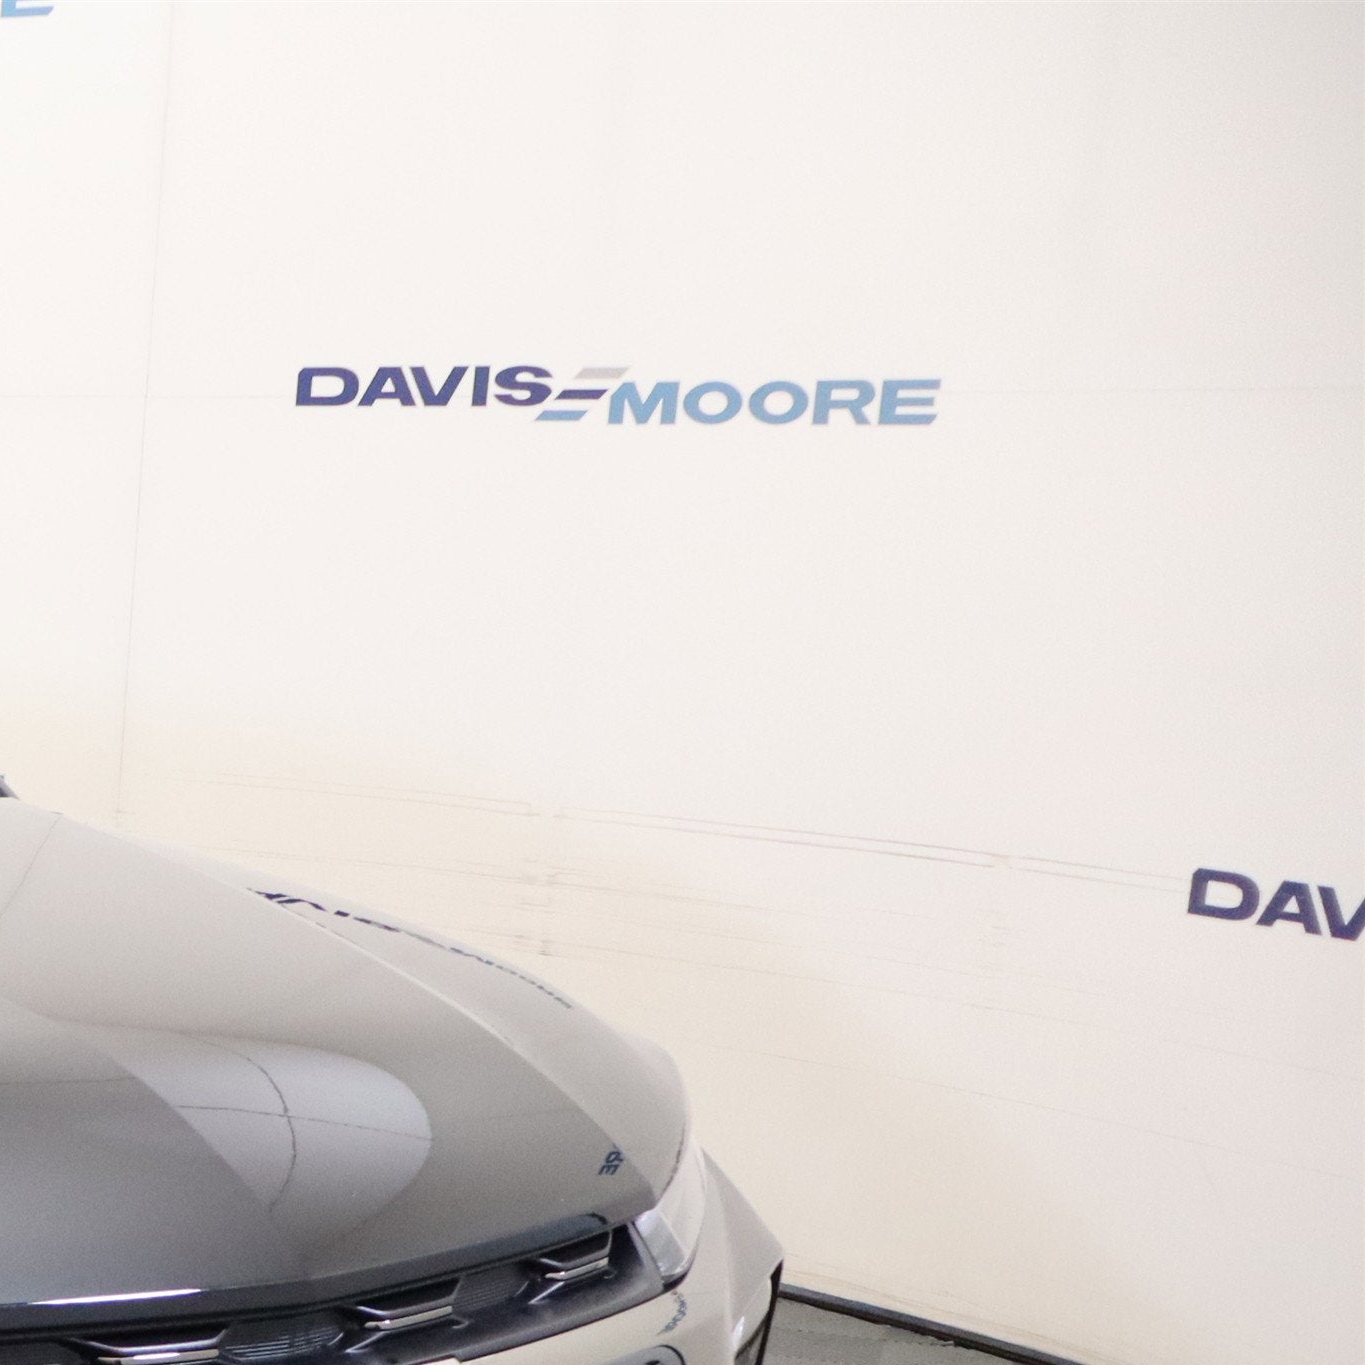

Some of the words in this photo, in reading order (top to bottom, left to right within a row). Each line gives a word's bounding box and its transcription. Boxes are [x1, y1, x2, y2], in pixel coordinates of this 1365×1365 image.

[294, 364, 553, 408] DAVIS
[607, 378, 943, 426] MOORE
[1187, 867, 1365, 942] DAV
